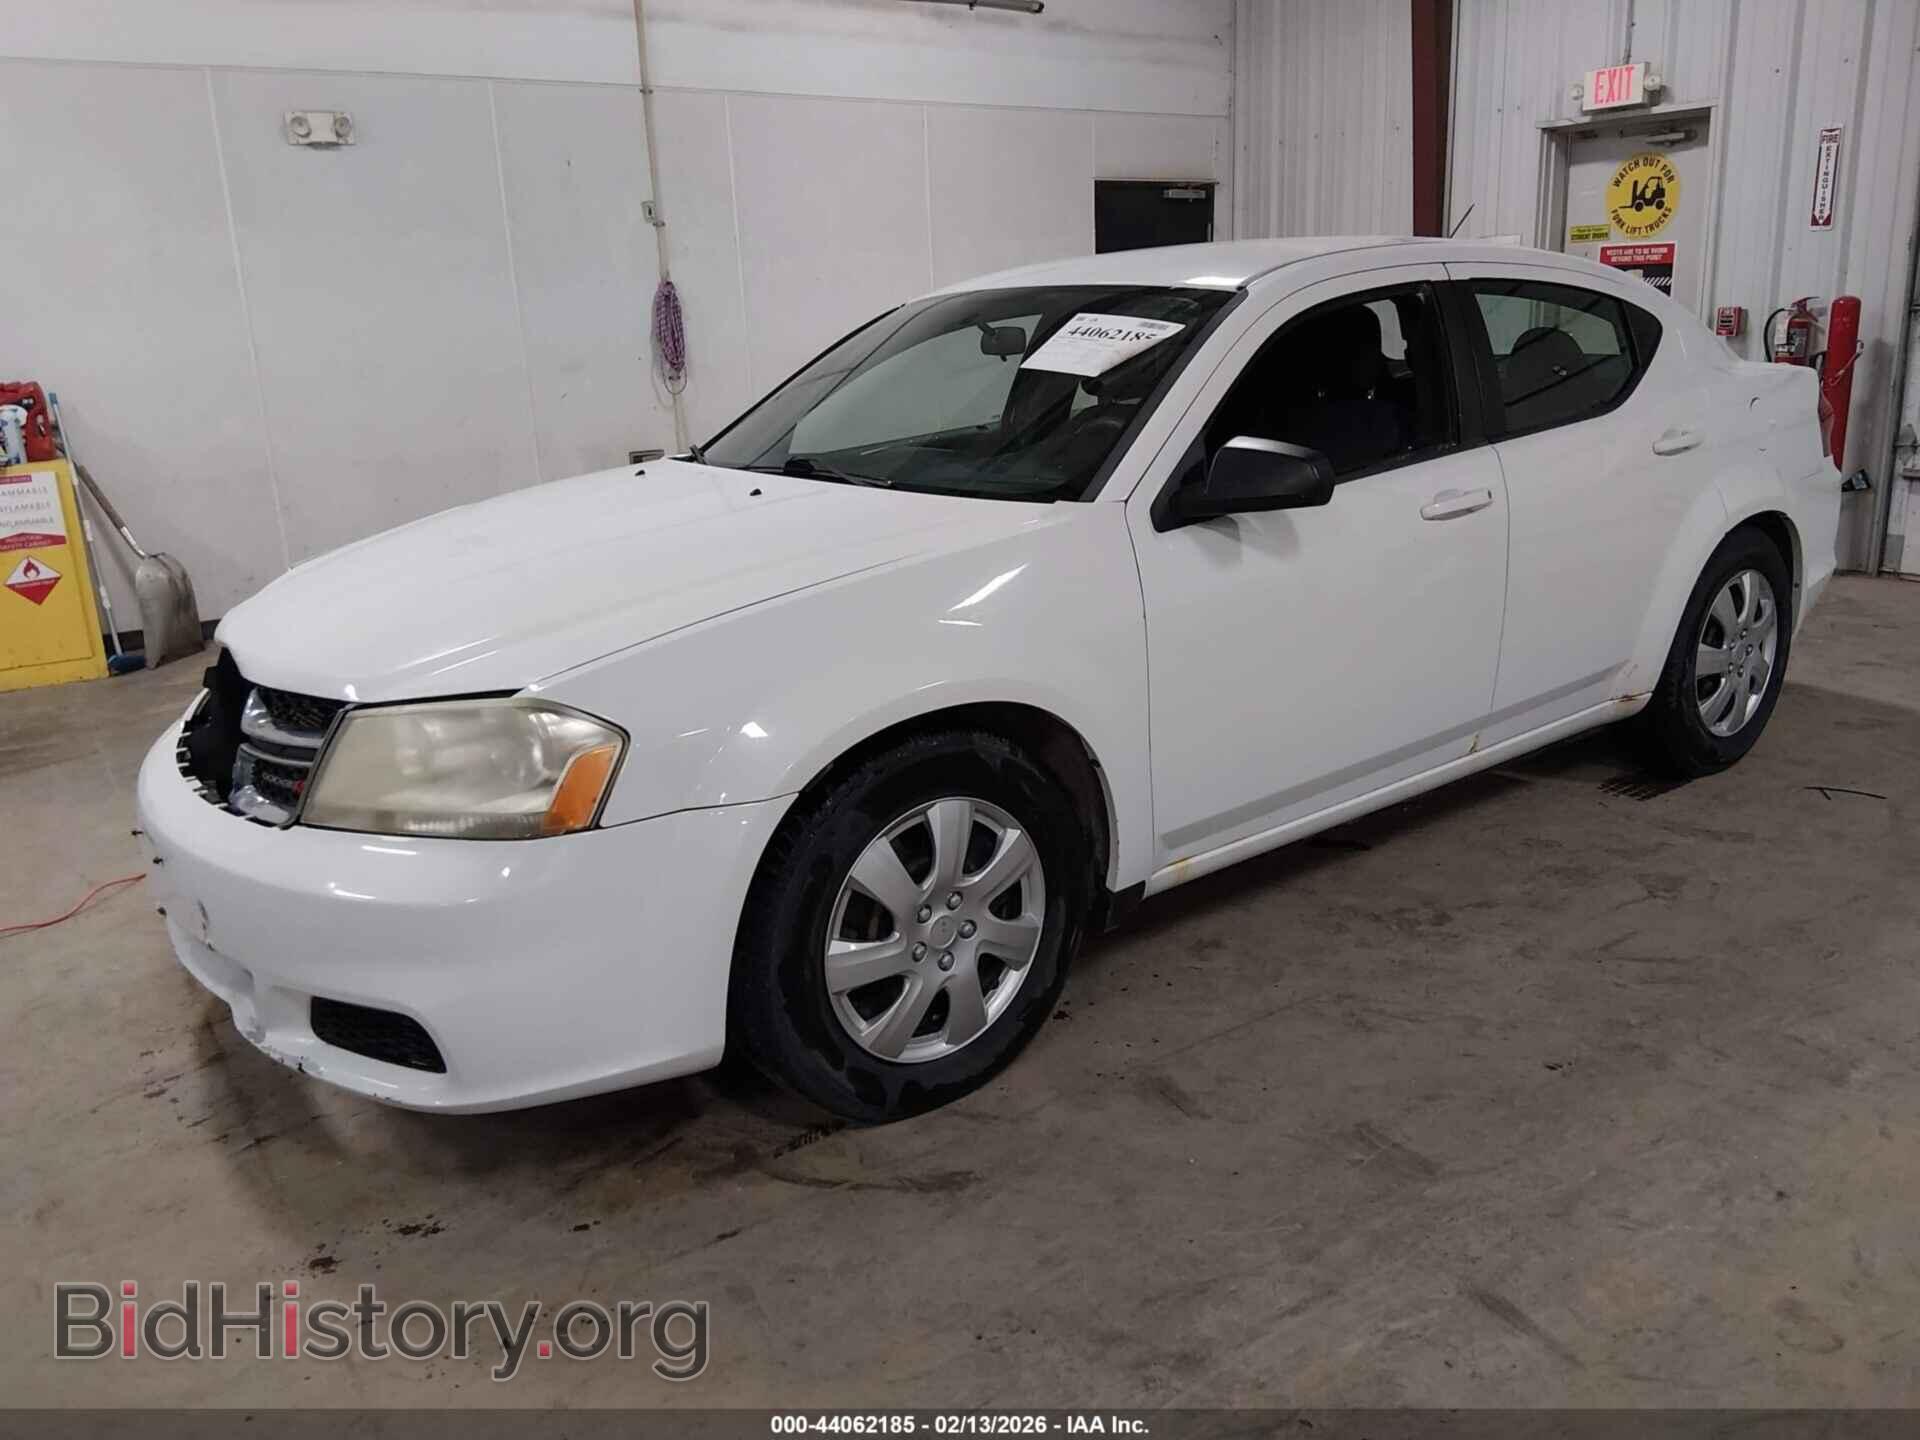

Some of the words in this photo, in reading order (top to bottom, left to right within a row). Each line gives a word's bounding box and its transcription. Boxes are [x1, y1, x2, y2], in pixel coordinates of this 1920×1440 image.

[1594, 65, 1634, 105] EXIT
[1822, 134, 1839, 143] FIRE
[1613, 159, 1640, 187] WATCH
[1643, 156, 1661, 168] OUT
[1660, 164, 1675, 184] FOR
[1818, 145, 1832, 220] EXTINGUISHER
[1611, 209, 1625, 229] FORK
